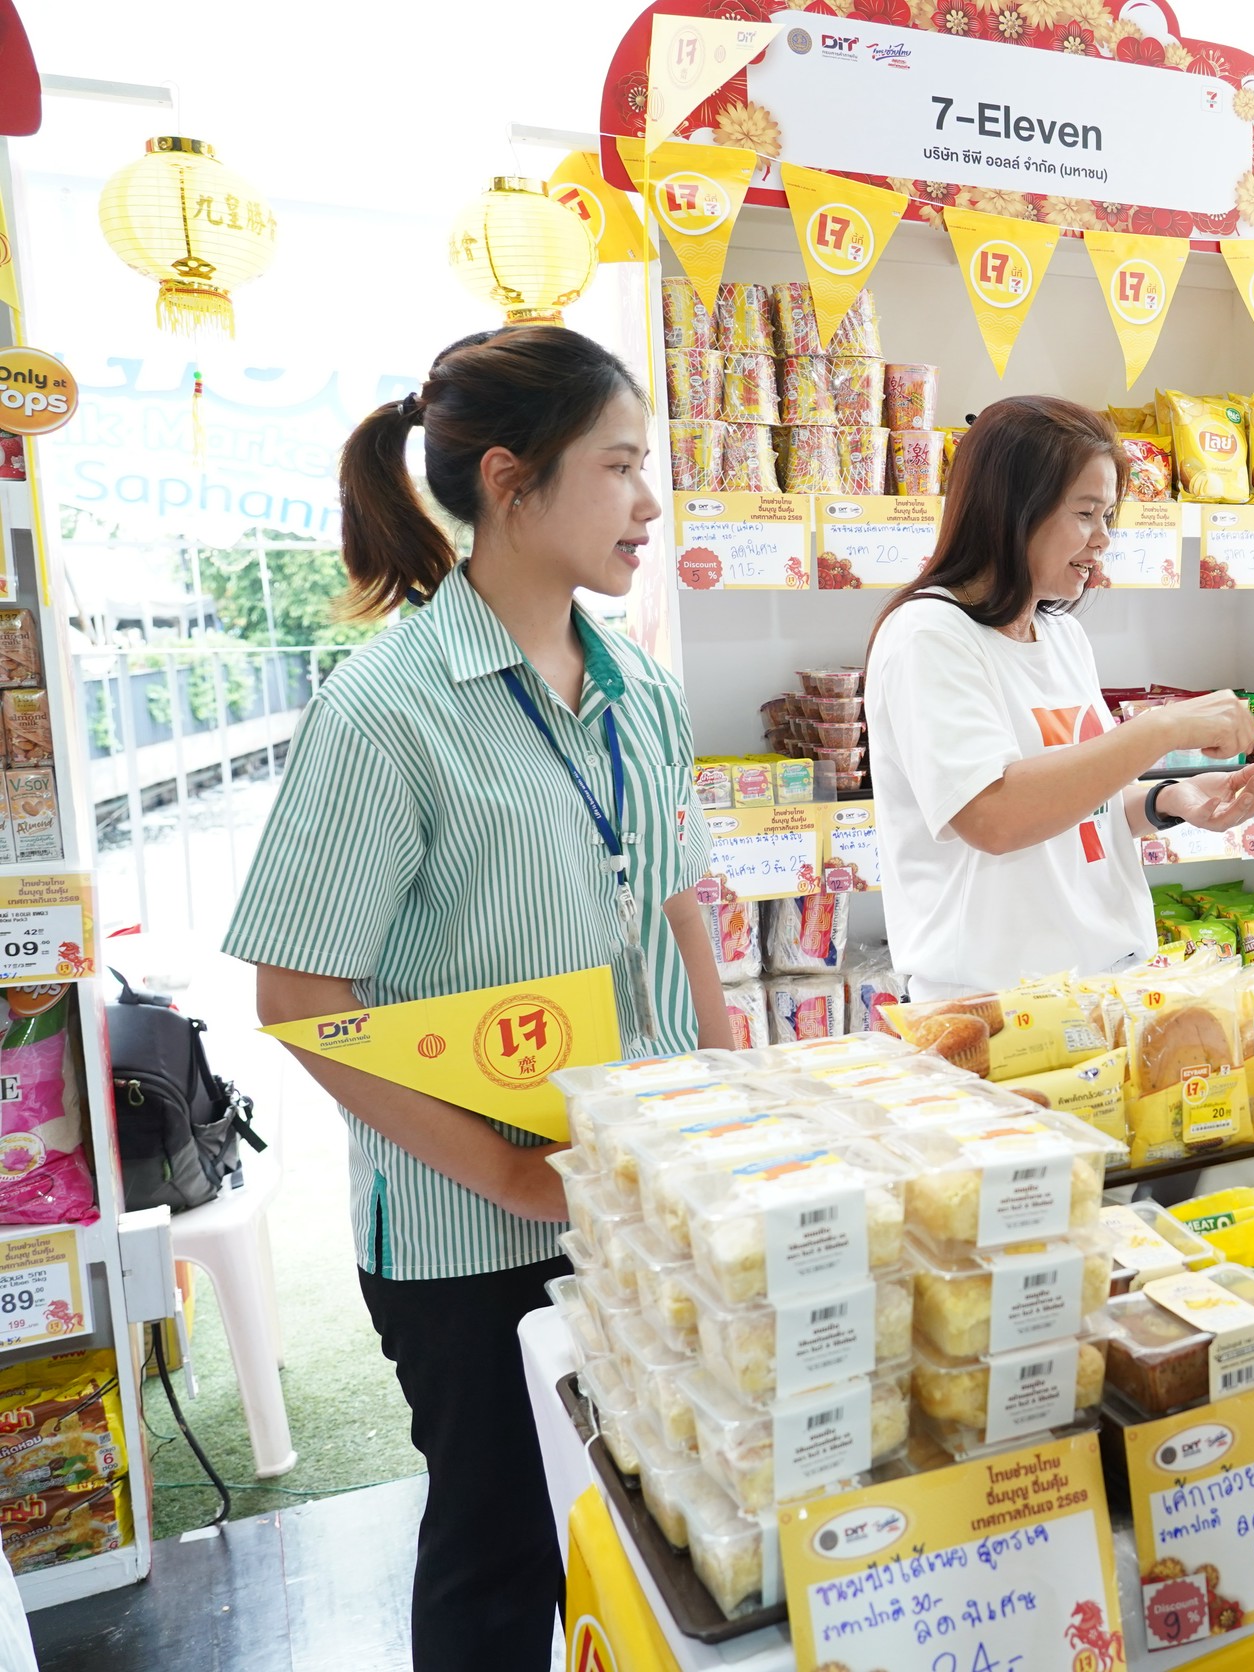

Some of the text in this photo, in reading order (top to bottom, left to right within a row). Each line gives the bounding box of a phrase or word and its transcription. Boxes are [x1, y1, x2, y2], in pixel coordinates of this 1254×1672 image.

[931, 94, 1103, 152] 7-Eleven
[923, 145, 1109, 183] บริษัท ซีพี ออลล์ จำกัด (มหาชน)
[52, 375, 68, 389] at
[683, 561, 717, 569] Discount
[708, 572, 717, 580] %
[9, 778, 49, 792] V-SOY
[17, 816, 54, 834] Almond
[1148, 992, 1161, 1006] เจ
[1017, 1013, 1030, 1026] เจ
[496, 1008, 548, 1059] เจ
[8, 1319, 25, 1329] 199
[103, 1452, 114, 1465] 6
[1153, 1598, 1199, 1614] Discount
[1188, 1611, 1200, 1623] %
